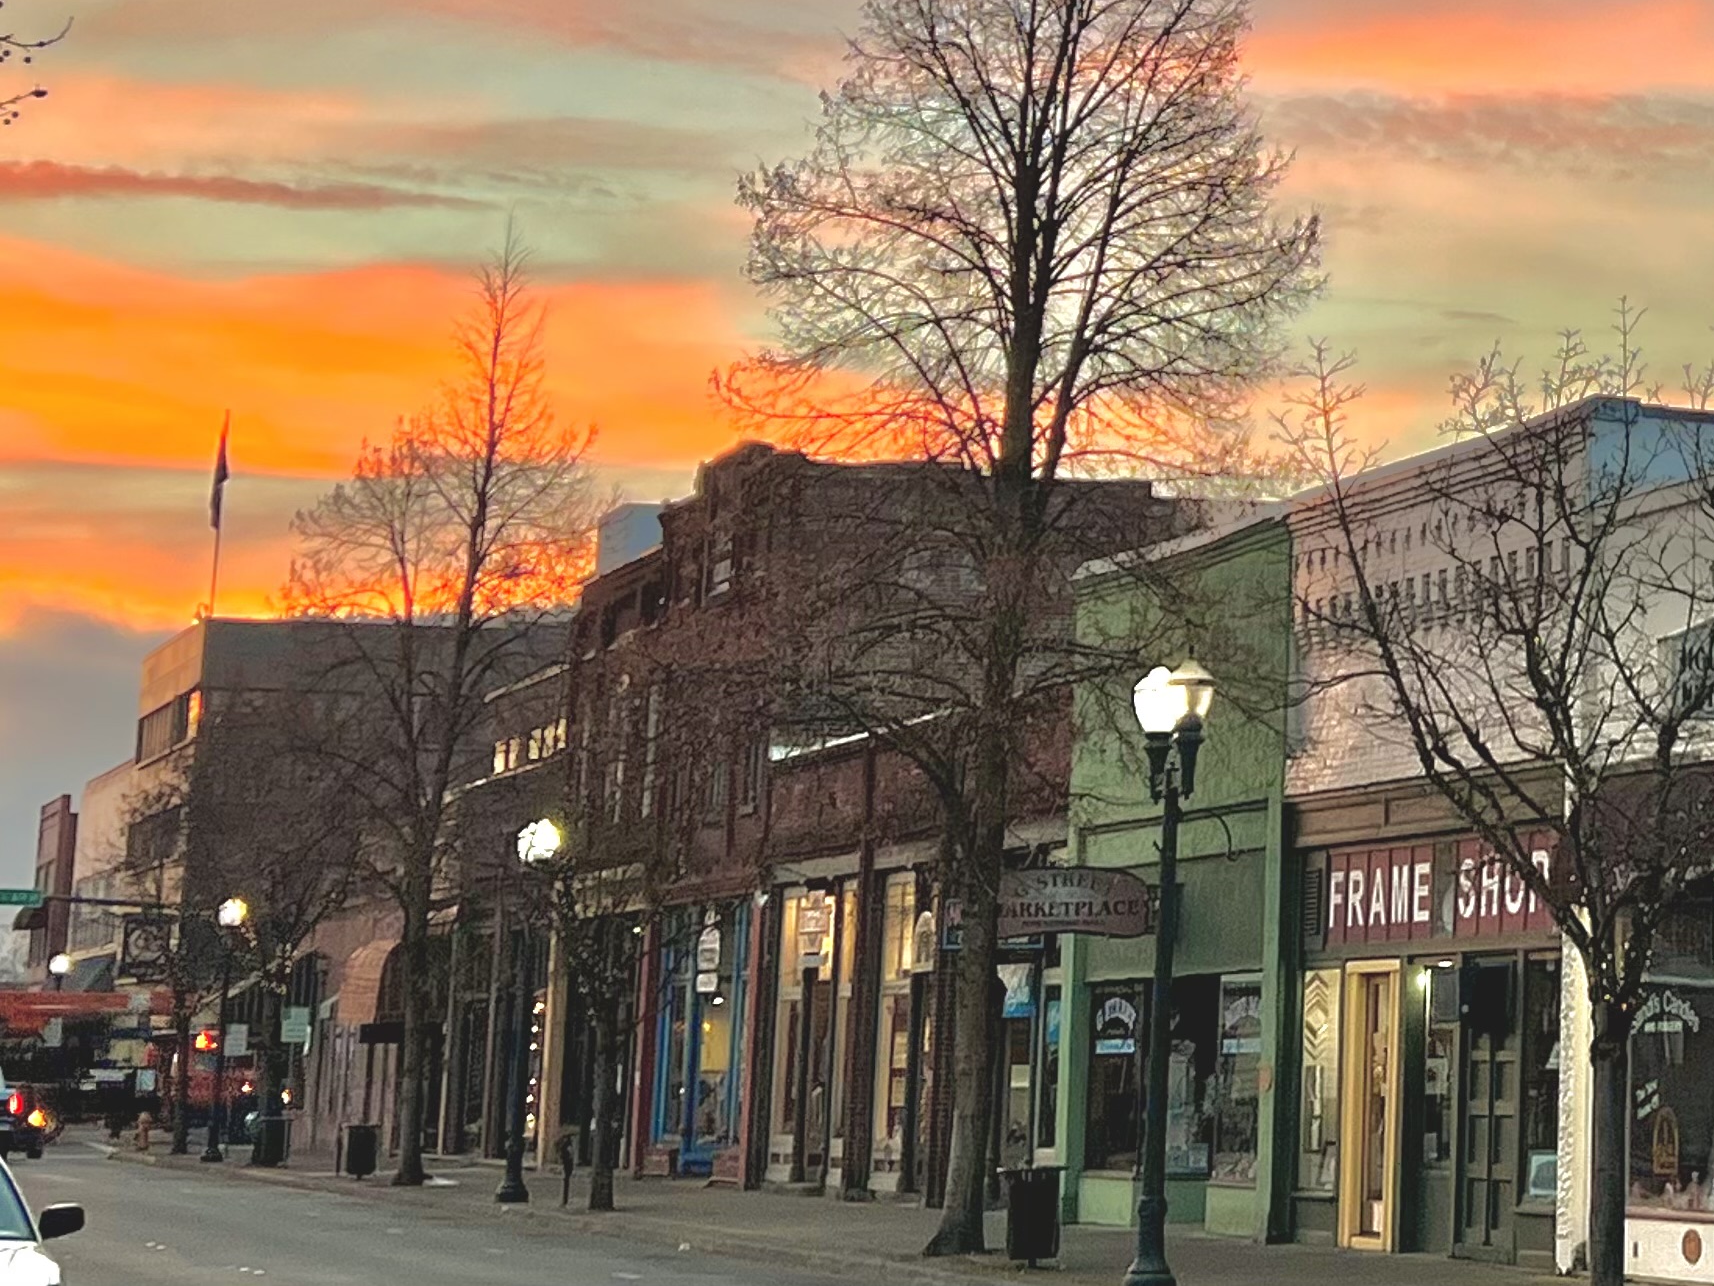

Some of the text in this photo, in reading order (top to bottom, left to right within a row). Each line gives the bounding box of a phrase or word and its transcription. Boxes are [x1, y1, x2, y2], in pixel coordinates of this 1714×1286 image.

[1000, 899, 1141, 919] ARKETPLACE
[1328, 849, 1550, 929] FRAME SHOP
